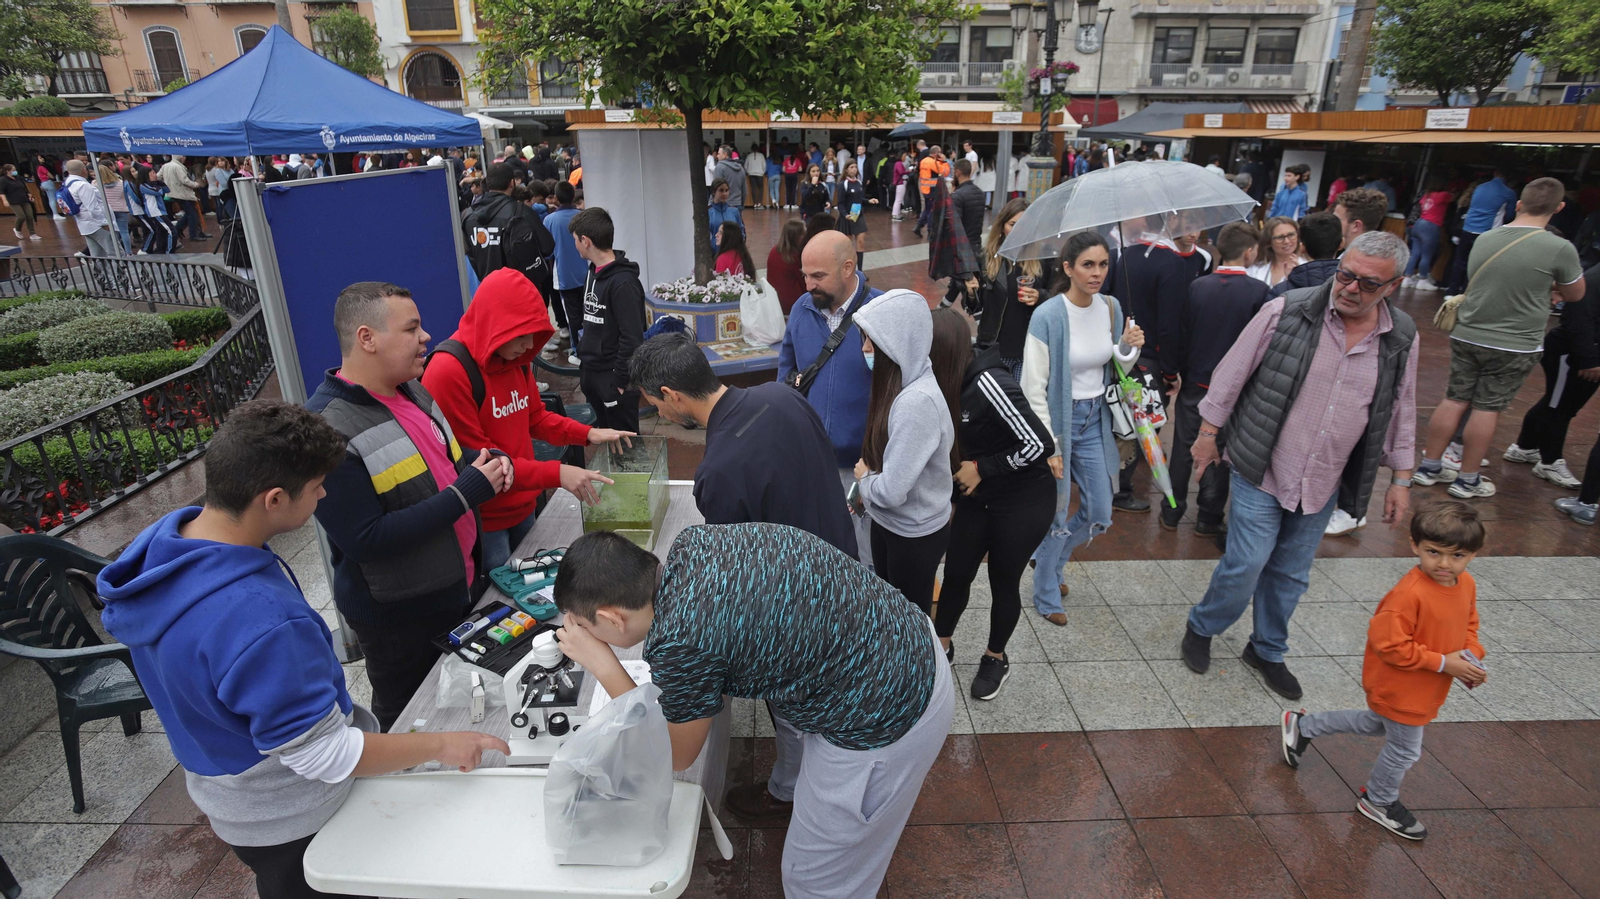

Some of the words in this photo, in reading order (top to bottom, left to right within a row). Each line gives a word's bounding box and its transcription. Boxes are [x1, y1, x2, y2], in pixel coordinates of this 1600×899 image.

[339, 133, 393, 145] Ayuntamiento
[393, 132, 403, 141] de
[404, 132, 436, 143] Algeciras
